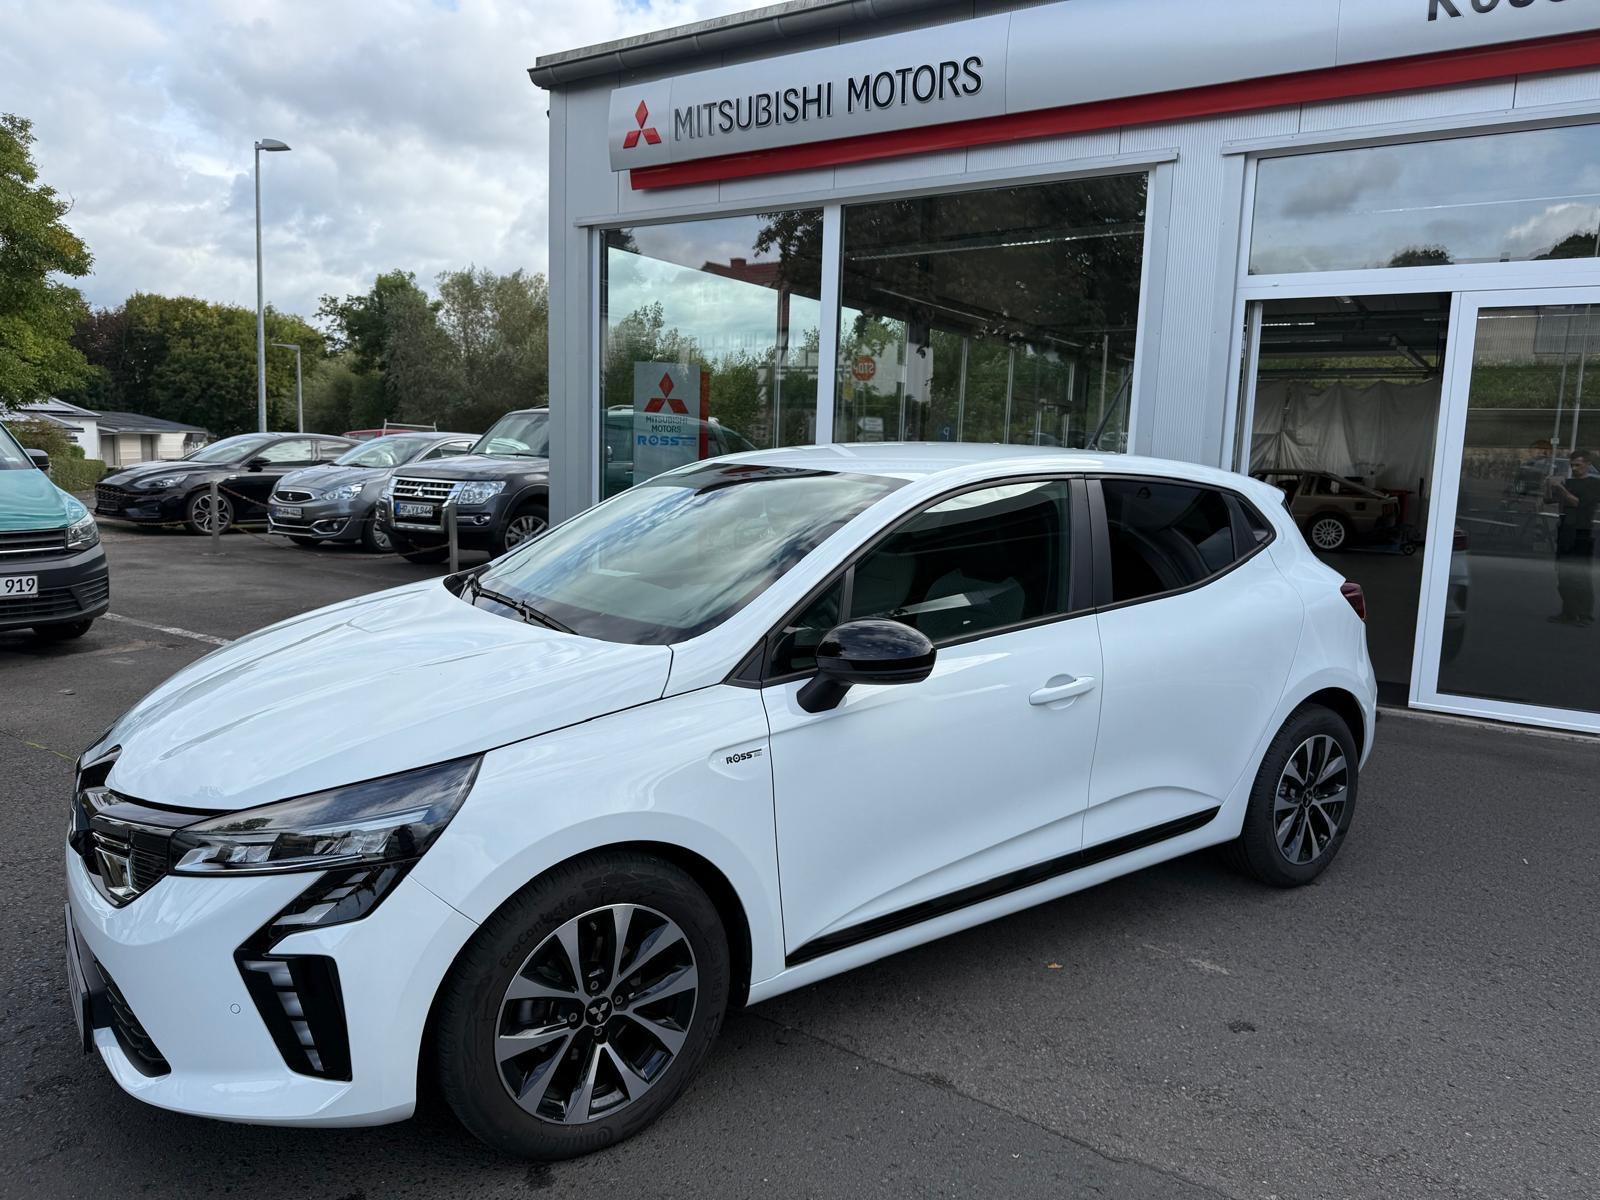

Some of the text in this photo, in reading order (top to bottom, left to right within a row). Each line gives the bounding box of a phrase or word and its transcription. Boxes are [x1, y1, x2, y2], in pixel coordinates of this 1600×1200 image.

[674, 56, 984, 142] MITSUBISHI MOTORS
[645, 415, 688, 425] MITSUBISHI
[651, 424, 682, 433] MOTORS
[637, 434, 684, 446] ROSS
[5, 578, 35, 593] 919
[726, 751, 754, 764] ROSS
